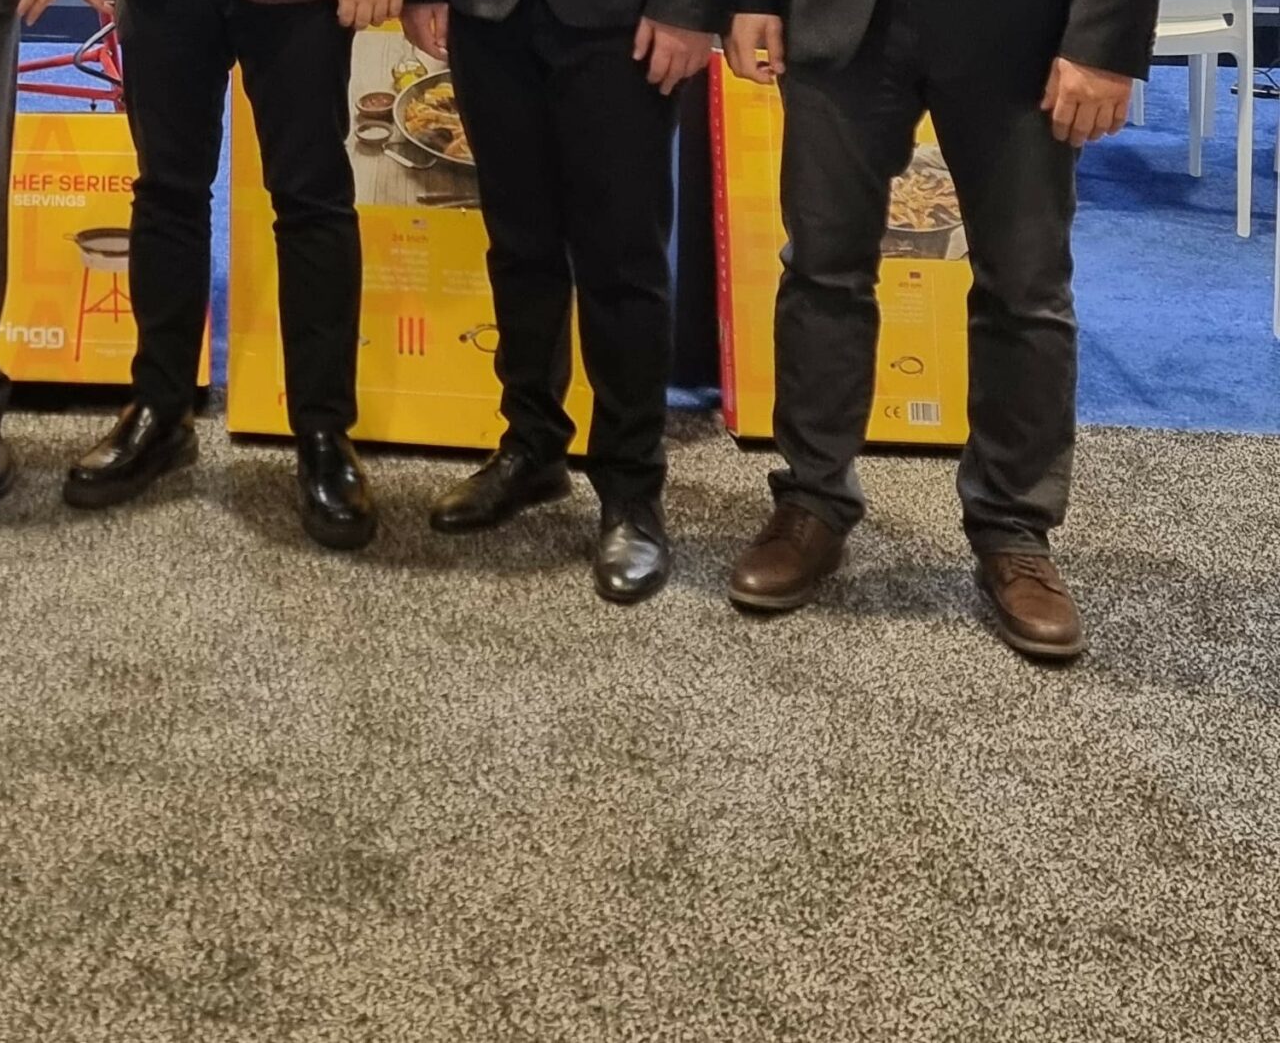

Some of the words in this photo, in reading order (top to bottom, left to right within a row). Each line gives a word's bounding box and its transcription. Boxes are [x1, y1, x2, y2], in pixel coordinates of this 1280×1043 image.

[12, 175, 52, 191] HEF
[59, 175, 133, 192] SERIES
[14, 194, 86, 207] SERVINGS
